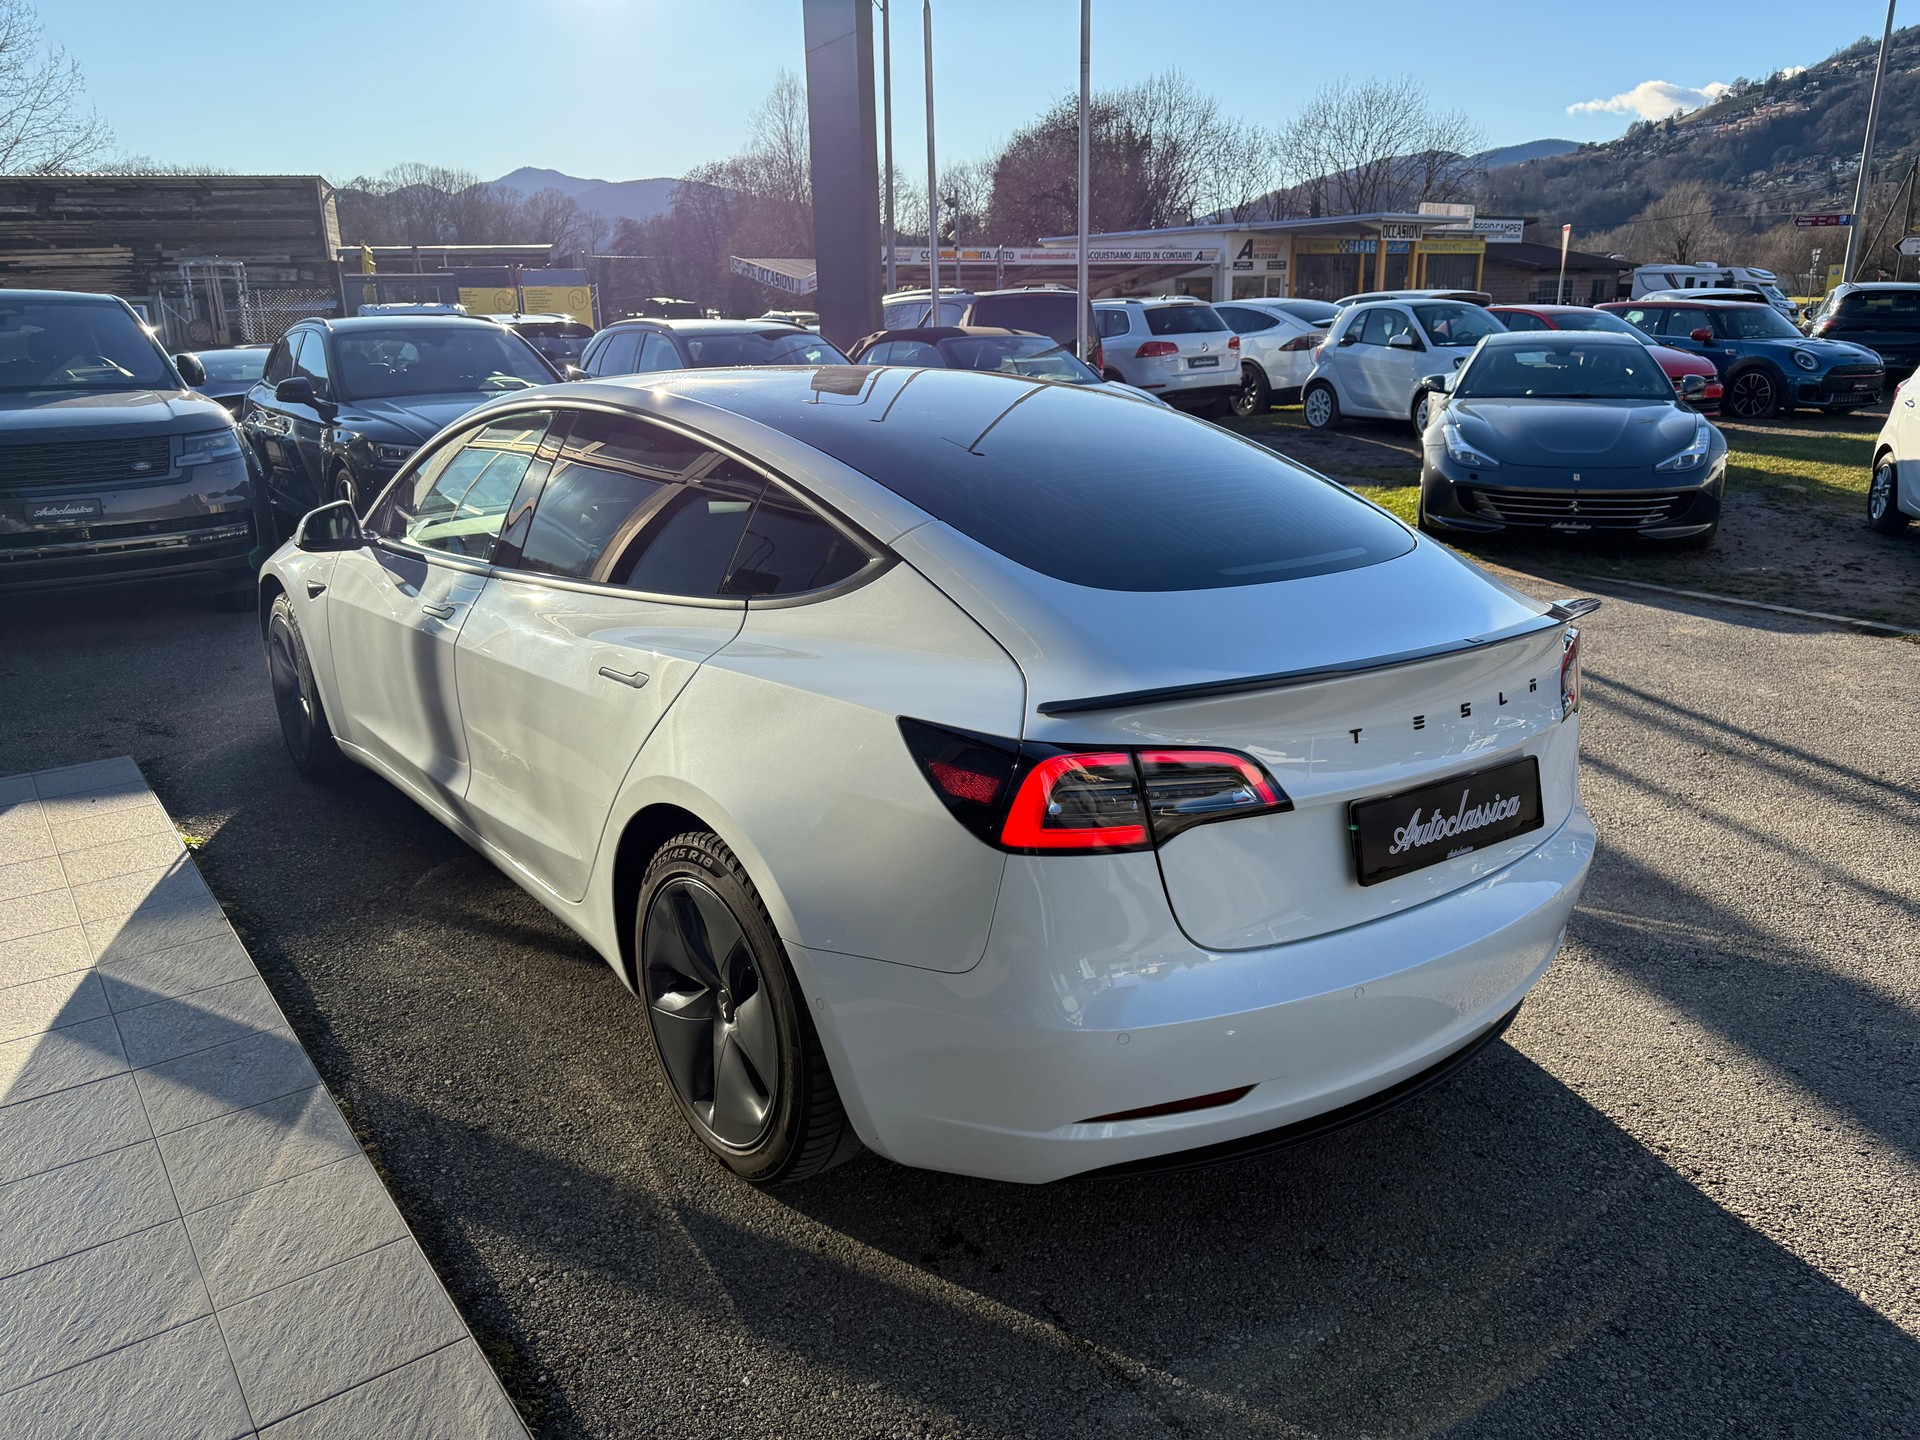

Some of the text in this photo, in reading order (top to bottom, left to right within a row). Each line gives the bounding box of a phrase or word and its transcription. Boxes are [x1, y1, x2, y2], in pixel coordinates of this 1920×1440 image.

[1382, 224, 1422, 239] OCCASIONI
[1348, 240, 1377, 252] GARAG
[994, 251, 1014, 259] ATO
[1133, 251, 1151, 259] AUTO
[1153, 251, 1160, 259] IN
[1161, 251, 1193, 259] CONTANTI
[757, 266, 795, 292] OCCASIONI
[33, 504, 95, 517] Autoclassica
[1349, 678, 1537, 744] TESLA
[1389, 788, 1521, 855] Autoclassica
